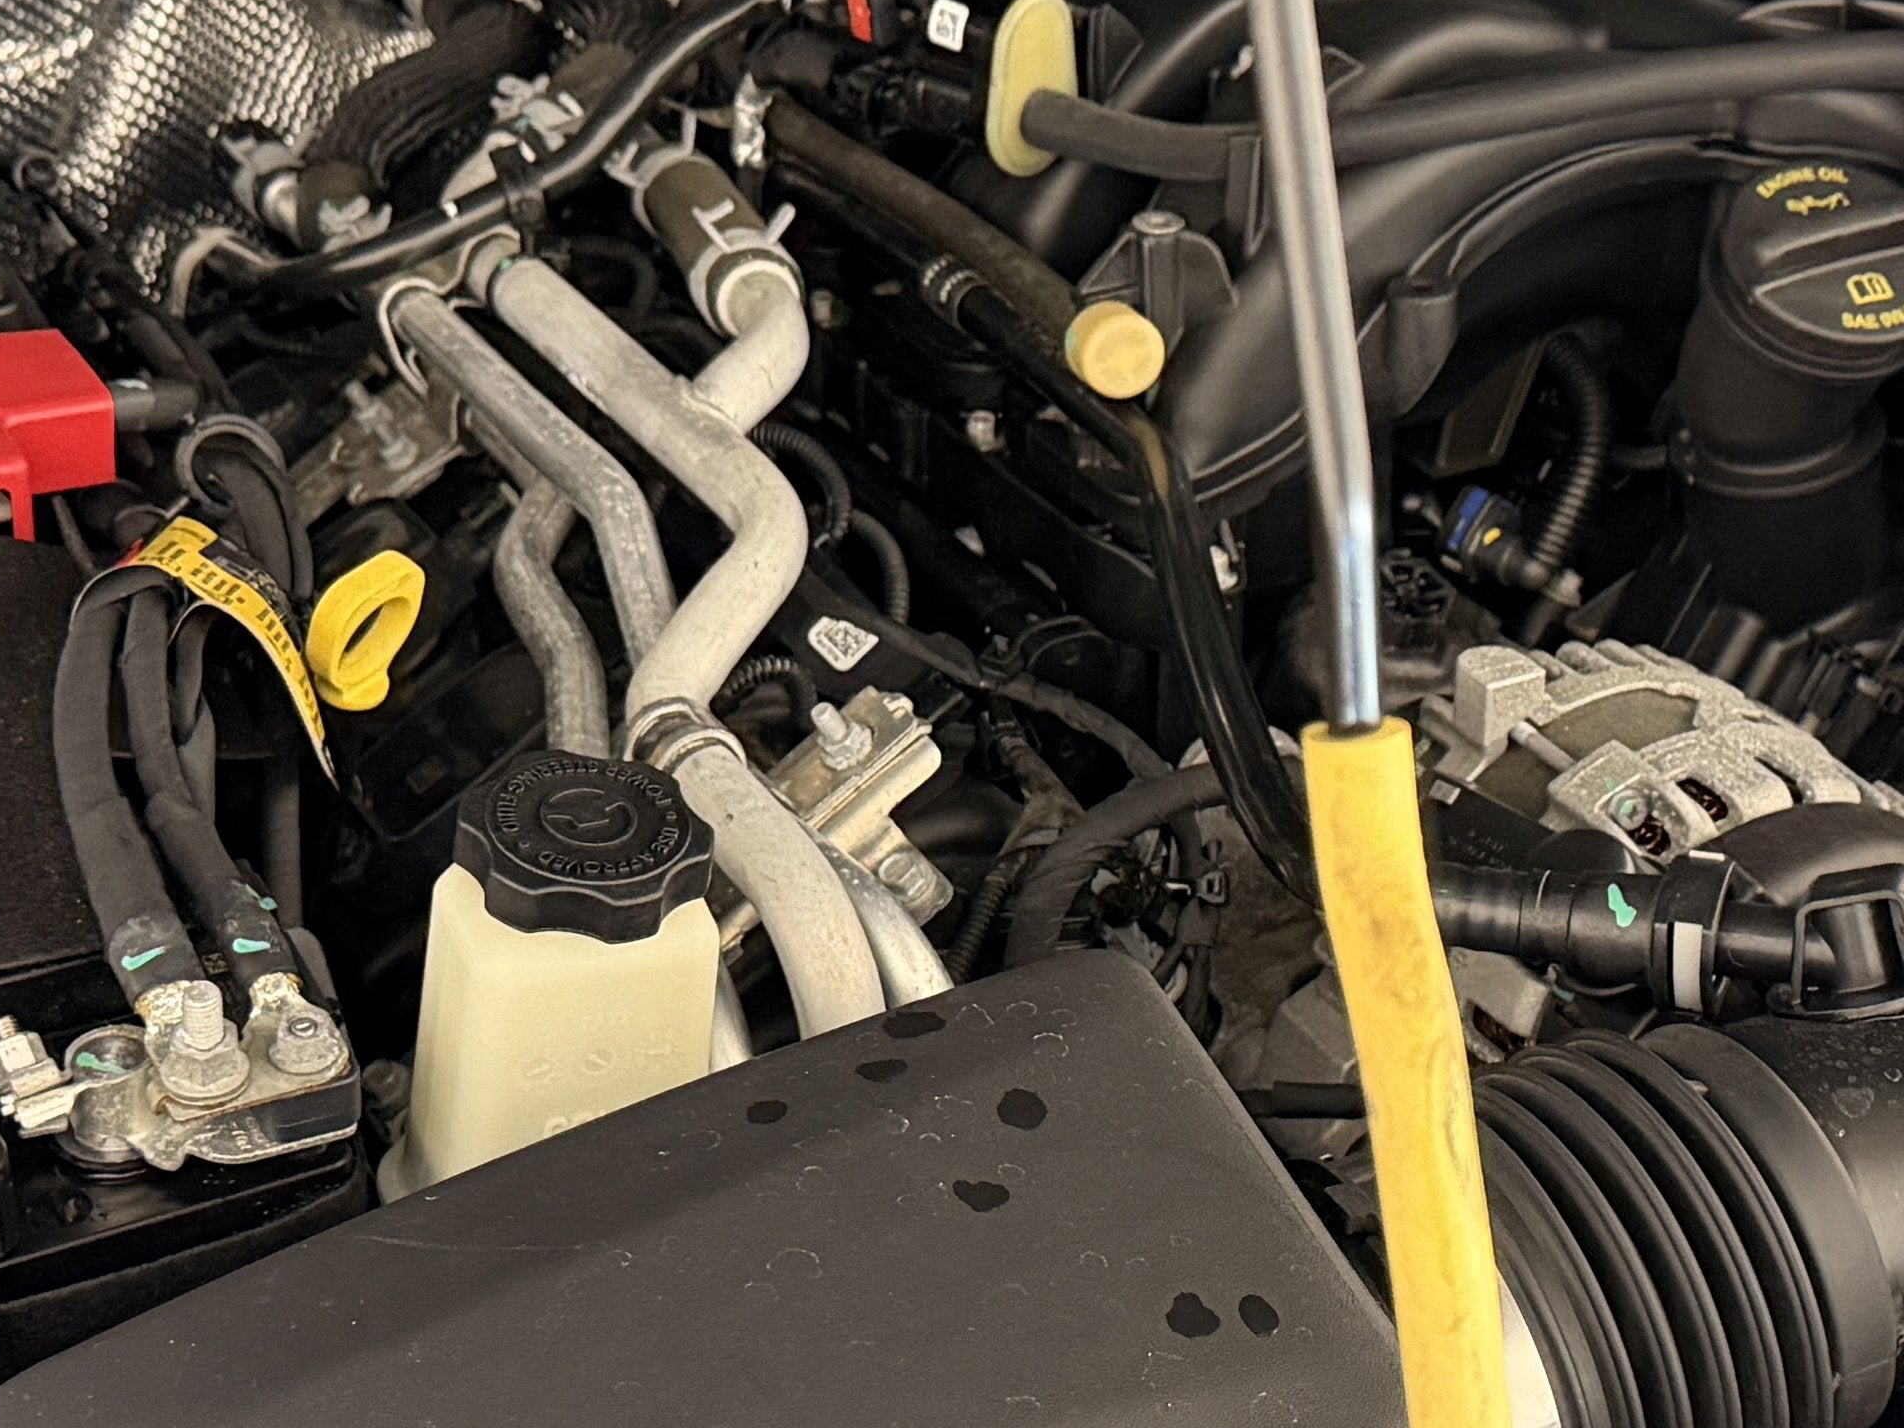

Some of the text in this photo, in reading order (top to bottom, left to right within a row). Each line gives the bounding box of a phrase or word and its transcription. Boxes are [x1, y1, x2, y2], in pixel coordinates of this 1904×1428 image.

[1755, 165, 1849, 199] ENGINE OIL
[1841, 311, 1879, 331] SAE
[507, 758, 599, 795] STEERING
[606, 762, 673, 807] POWER
[538, 826, 680, 876] USE APPROVED
